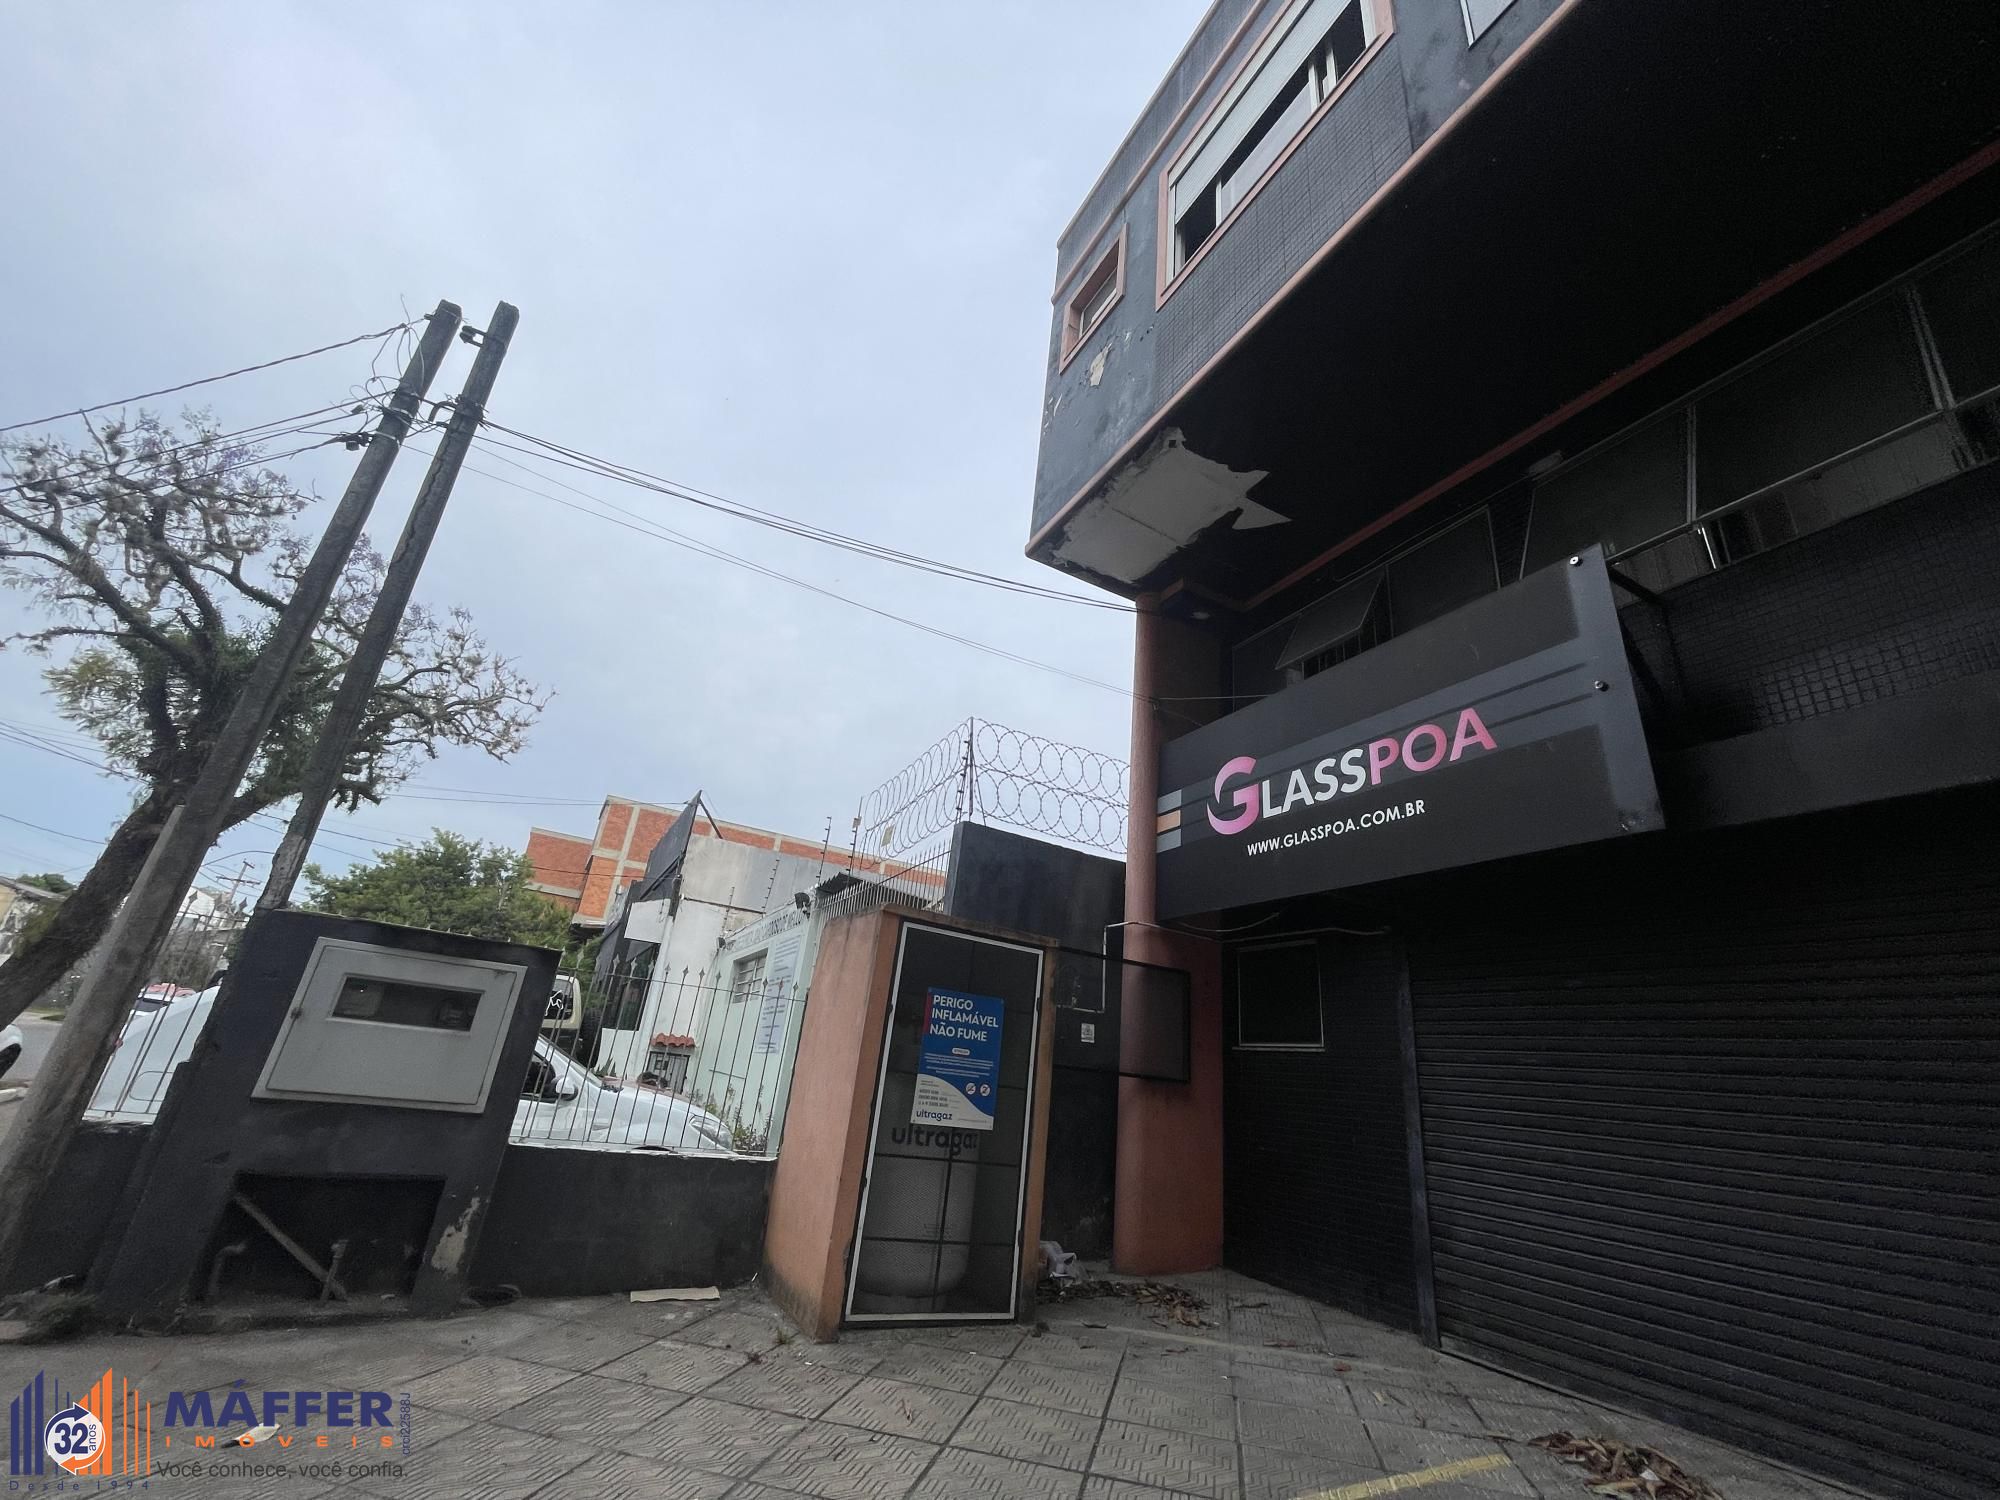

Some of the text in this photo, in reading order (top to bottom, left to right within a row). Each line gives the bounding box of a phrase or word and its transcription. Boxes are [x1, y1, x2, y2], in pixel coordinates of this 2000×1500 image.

[1207, 707, 1497, 835] GLASSPOA
[1247, 799, 1426, 856] WWW.GLASSPOA.COM.BR
[933, 995, 973, 1010] PERIGO
[931, 1008, 999, 1027] INFLAMÁVEL
[929, 1022, 987, 1041] NÃO FUME
[916, 1109, 953, 1121] ultragaz
